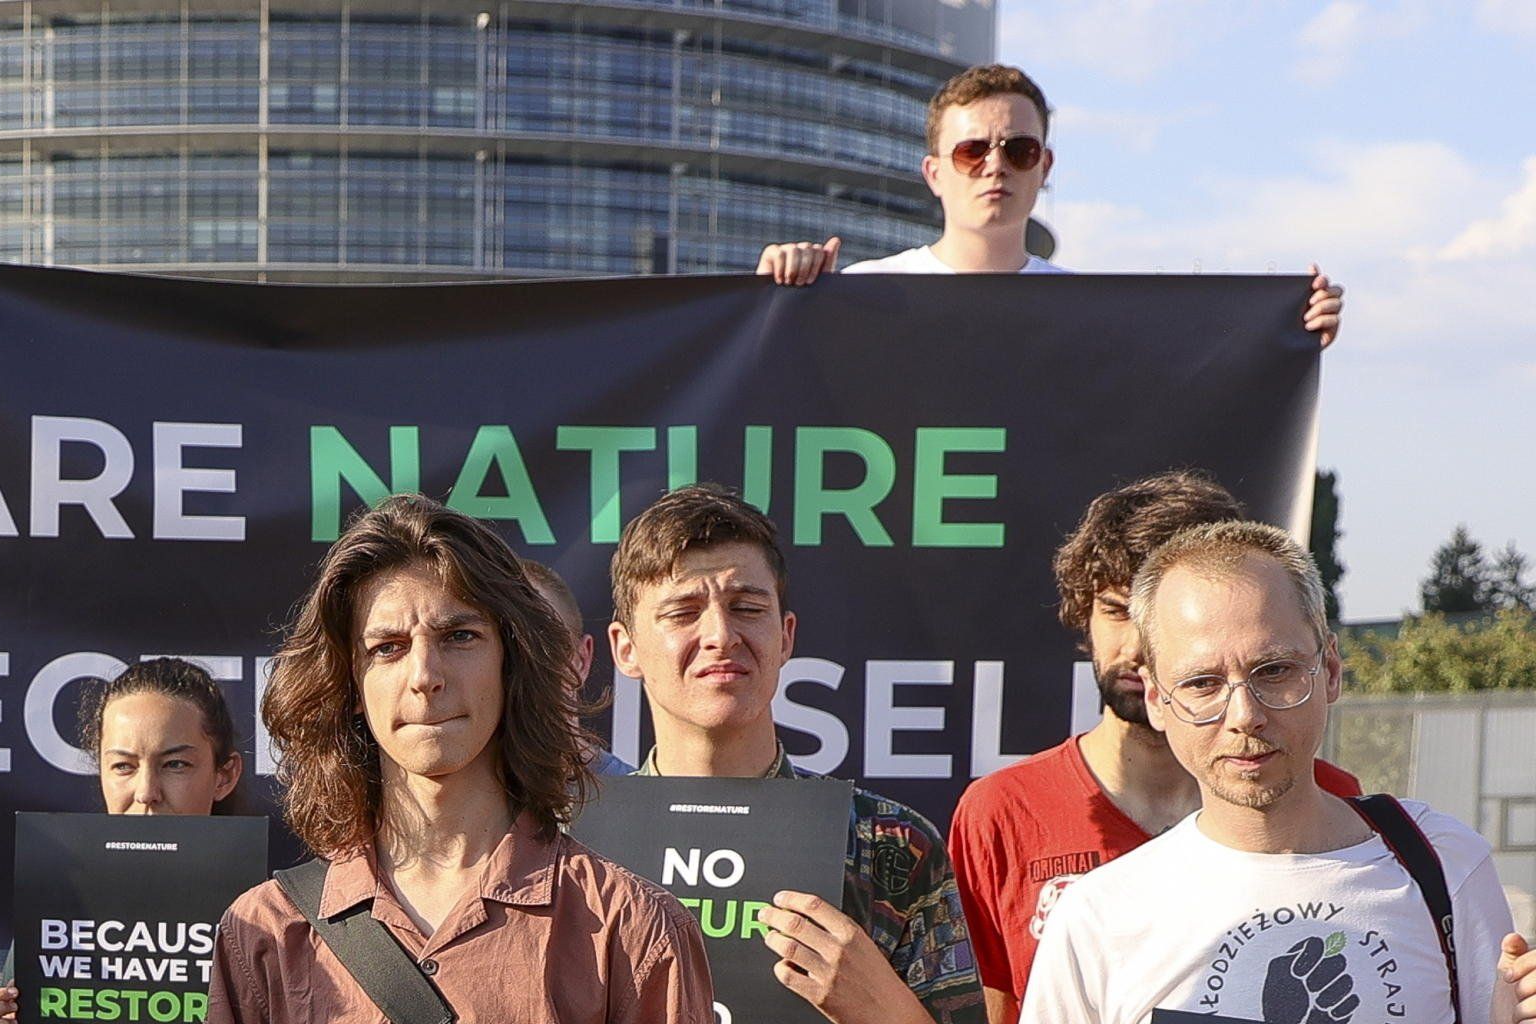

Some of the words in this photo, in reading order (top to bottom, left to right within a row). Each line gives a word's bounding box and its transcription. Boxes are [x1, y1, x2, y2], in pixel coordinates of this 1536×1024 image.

[670, 804, 750, 815] #RESTORENATURE
[105, 841, 178, 852] #RESTORENATURE
[662, 847, 745, 887] NO
[40, 919, 220, 954] BECAUS
[39, 954, 92, 979] WE
[101, 956, 187, 982] HAVE
[39, 987, 209, 1024] RESTOR
